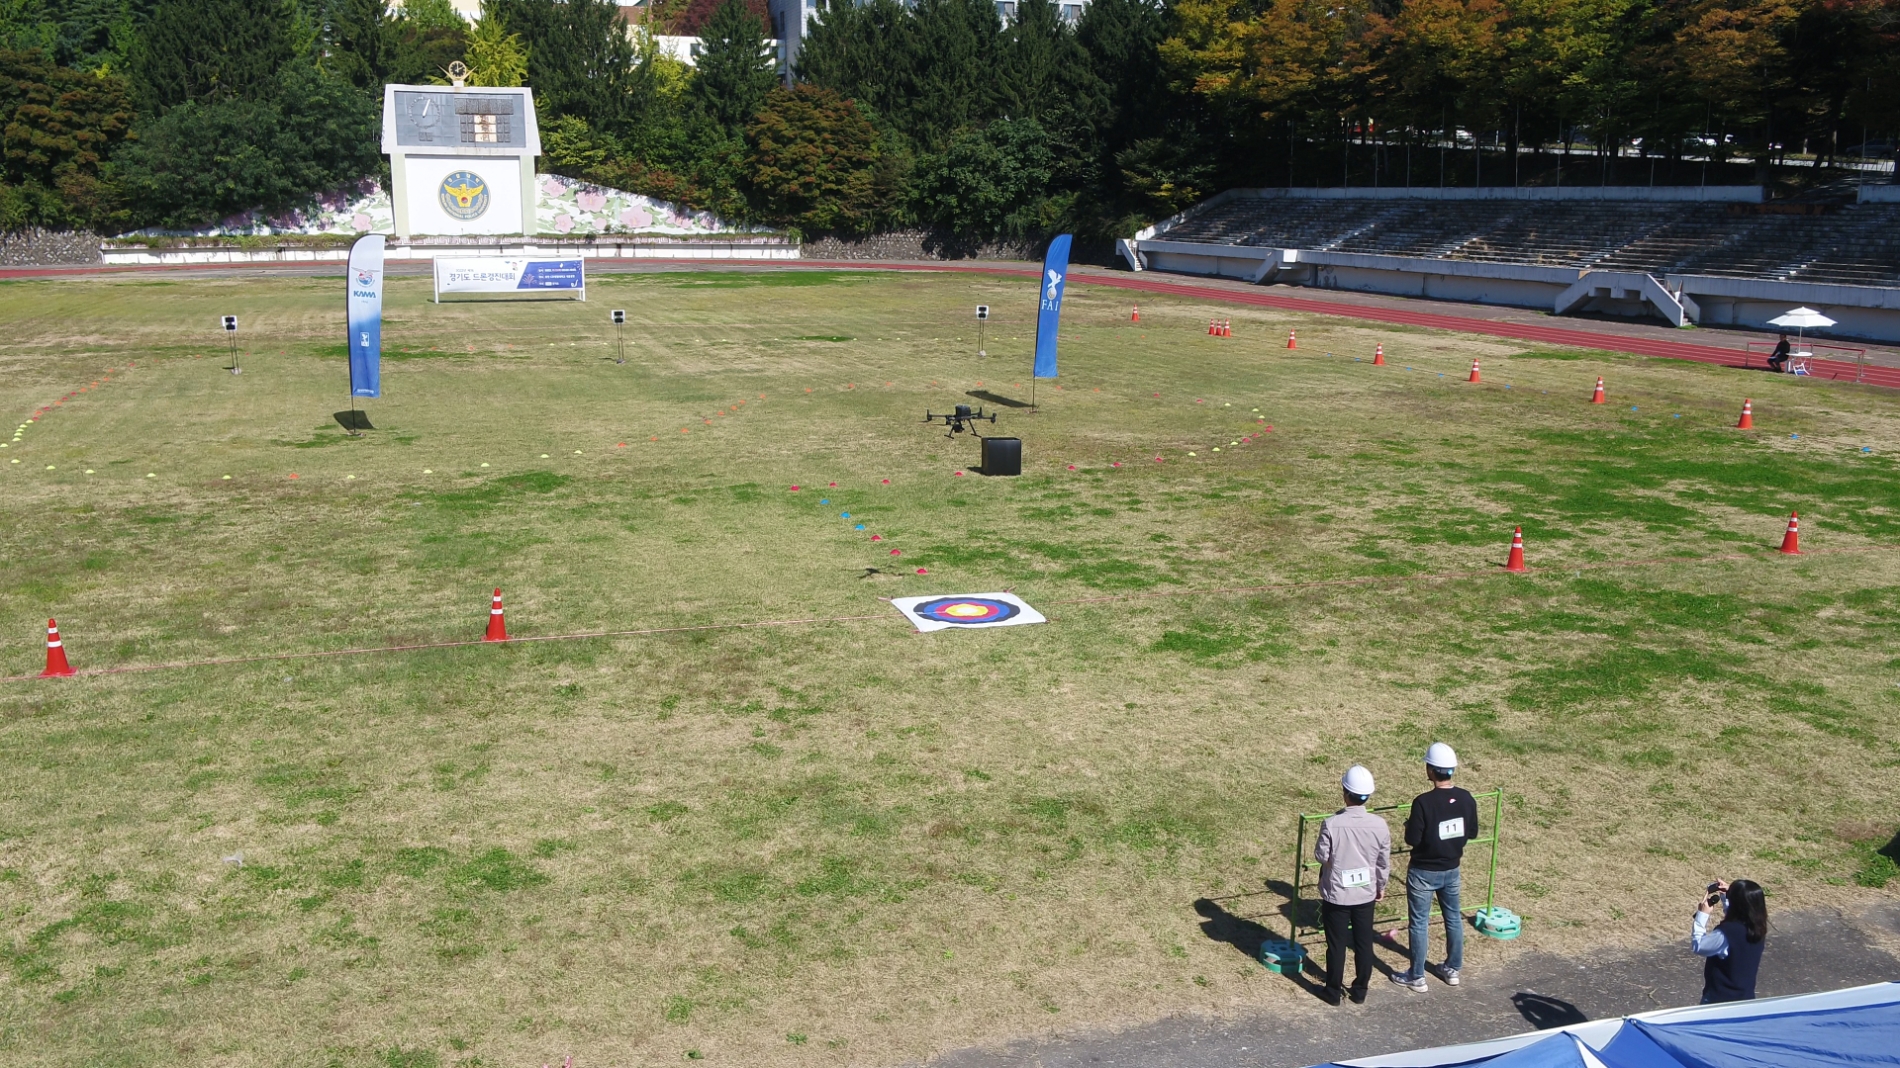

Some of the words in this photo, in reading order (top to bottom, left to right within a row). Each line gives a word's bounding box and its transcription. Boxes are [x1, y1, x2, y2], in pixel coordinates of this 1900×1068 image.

[449, 273, 471, 282] 경기도
[1041, 299, 1059, 311] FAI
[1445, 823, 1457, 833] 11
[1350, 873, 1363, 882] 11
